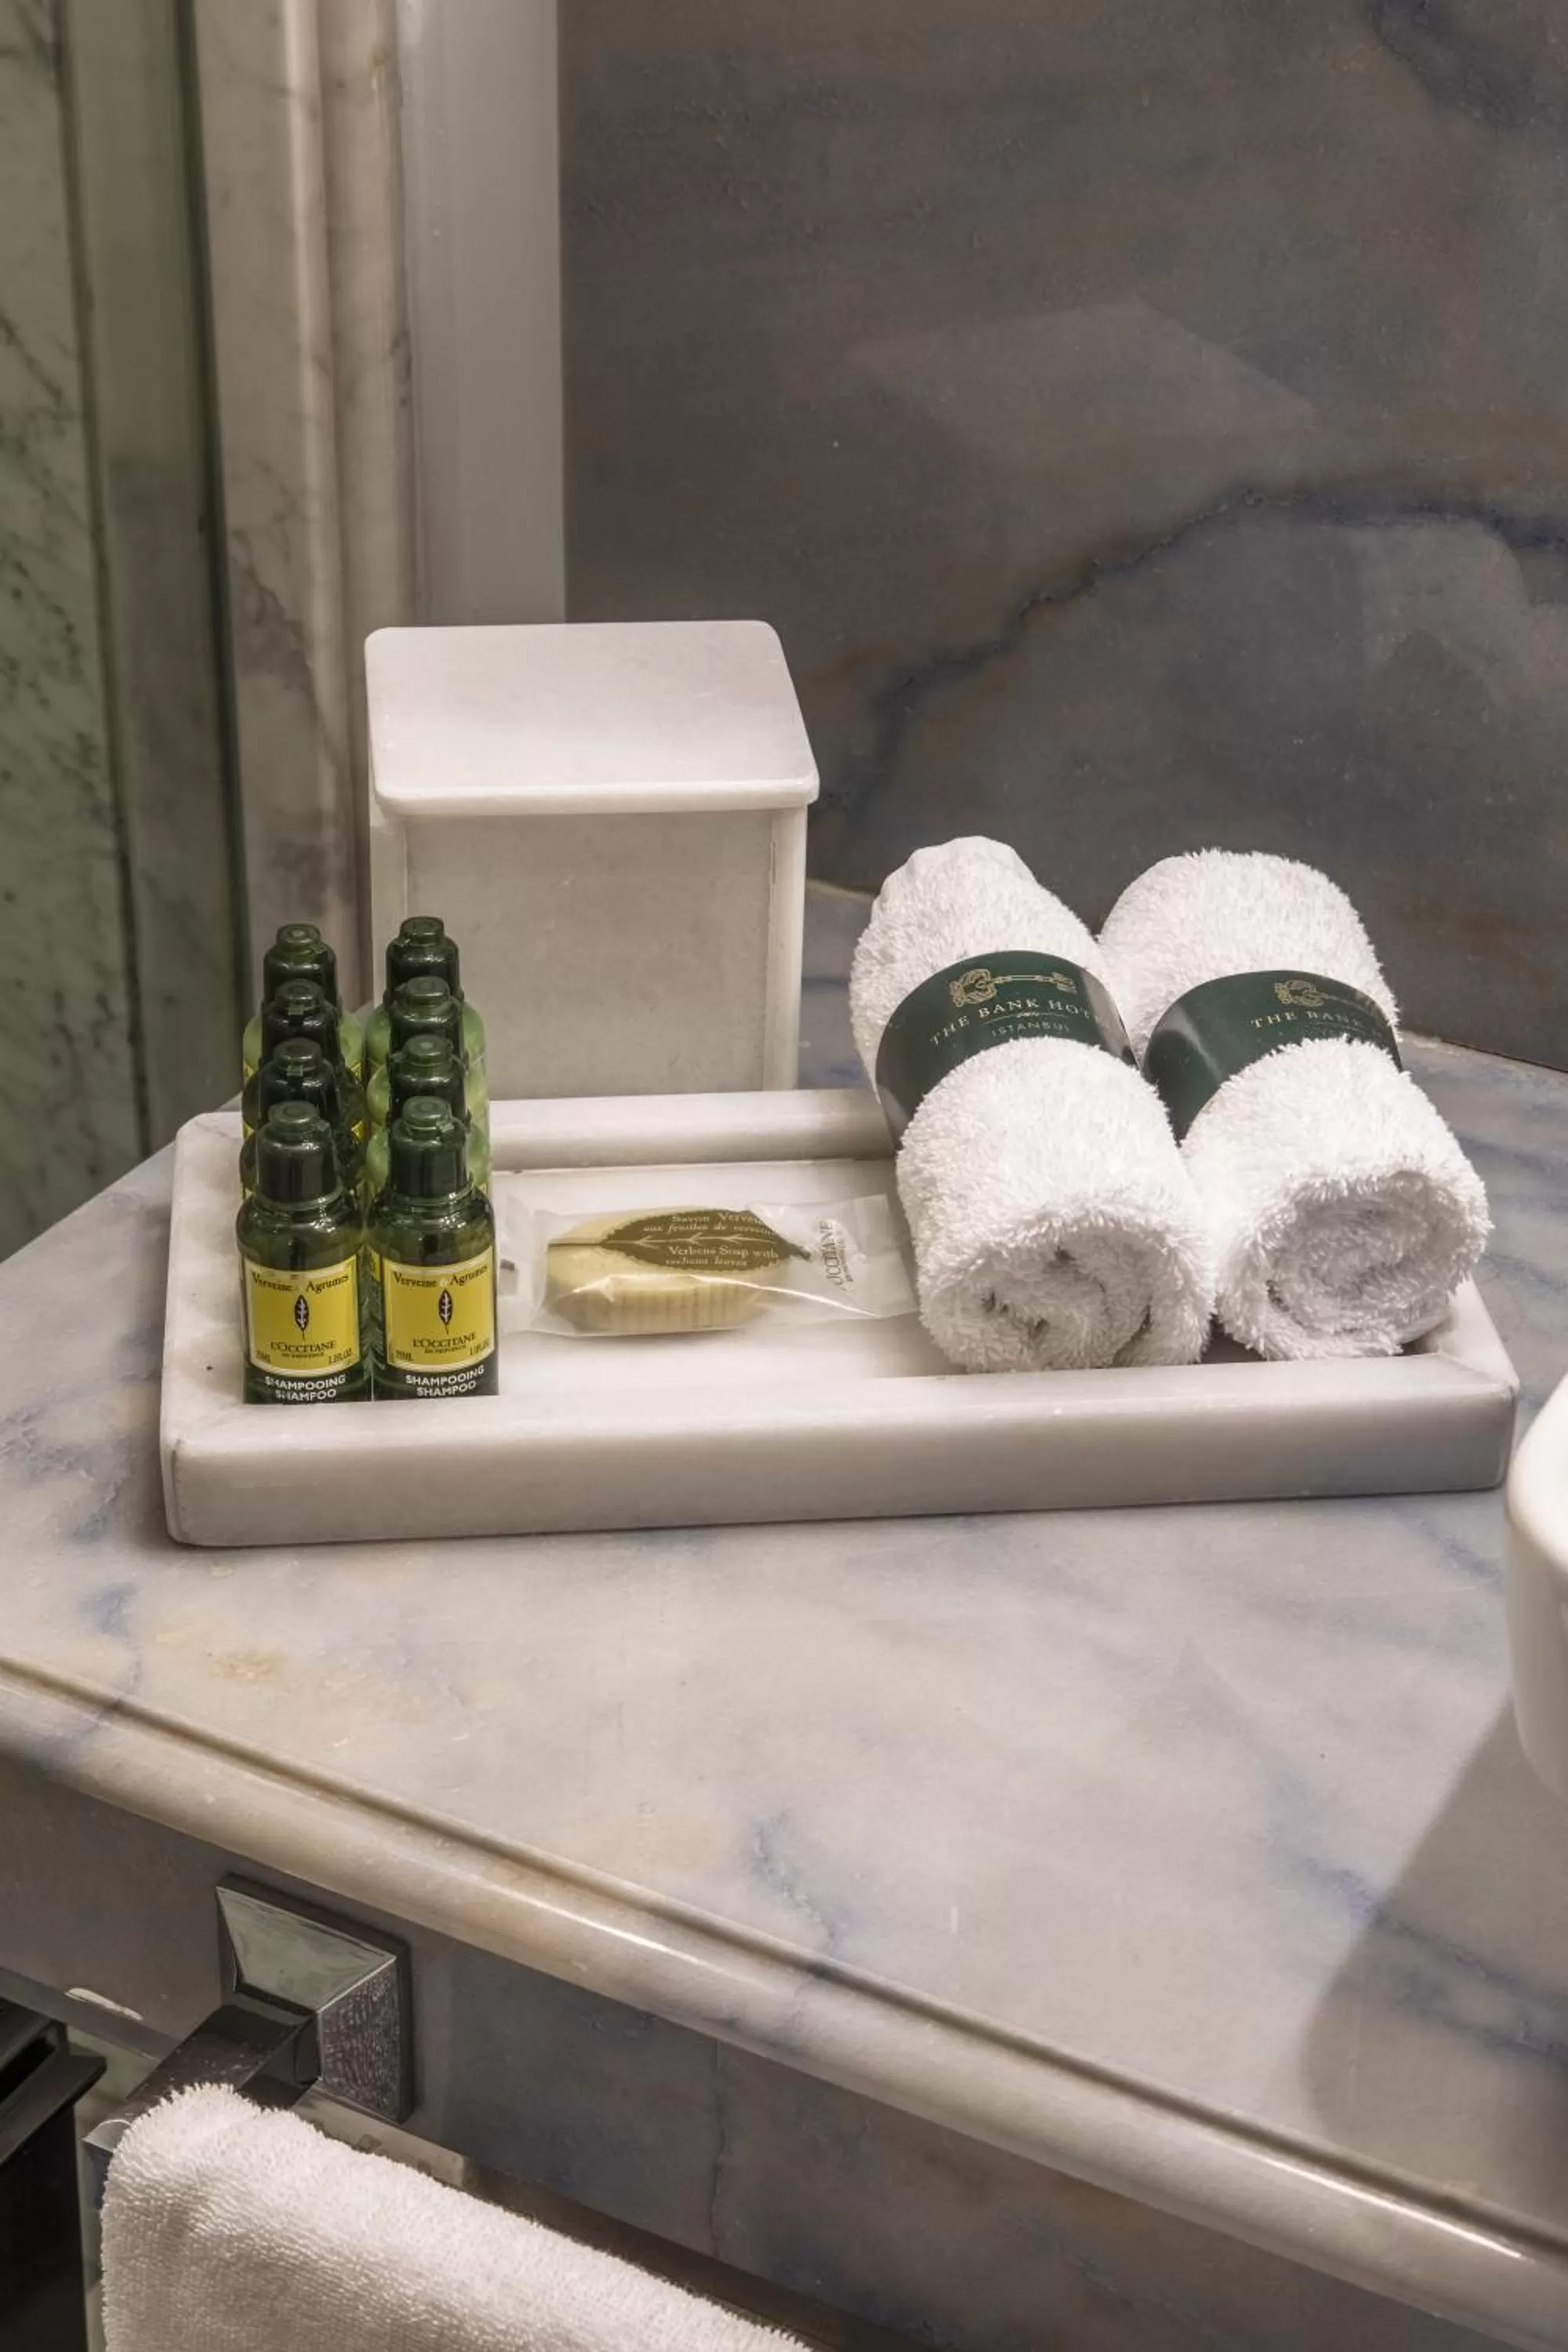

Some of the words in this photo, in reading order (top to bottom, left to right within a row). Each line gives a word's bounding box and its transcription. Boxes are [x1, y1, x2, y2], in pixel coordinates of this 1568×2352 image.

[930, 1016, 970, 1045] THE
[978, 998, 1039, 1018] BANK
[1048, 999, 1101, 1024] HOT
[1251, 1011, 1294, 1028] THE
[265, 1374, 346, 1390] SHAMPOOING
[405, 1365, 485, 1386] SHAMPOOING
[275, 1389, 336, 1401] SHAMPOO
[416, 1381, 477, 1396] SHAMPOO
